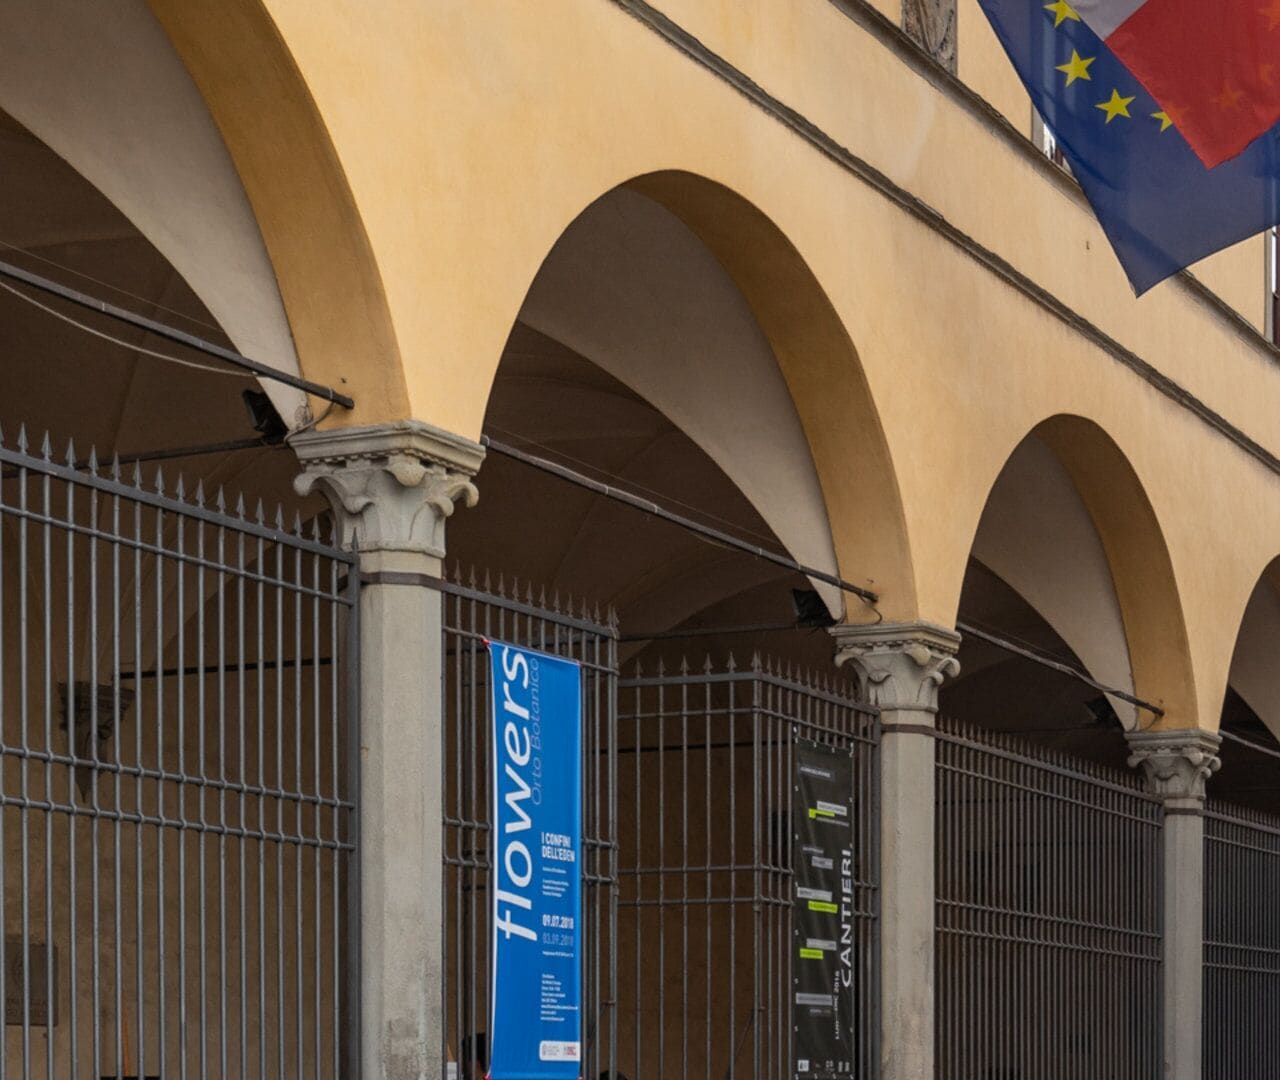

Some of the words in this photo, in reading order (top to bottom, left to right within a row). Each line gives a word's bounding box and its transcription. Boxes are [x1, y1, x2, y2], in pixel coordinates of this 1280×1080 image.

[530, 658, 542, 750] Botanico
[495, 646, 538, 941] flowers
[530, 757, 542, 805] Orto
[841, 849, 852, 987] CANTIERI
